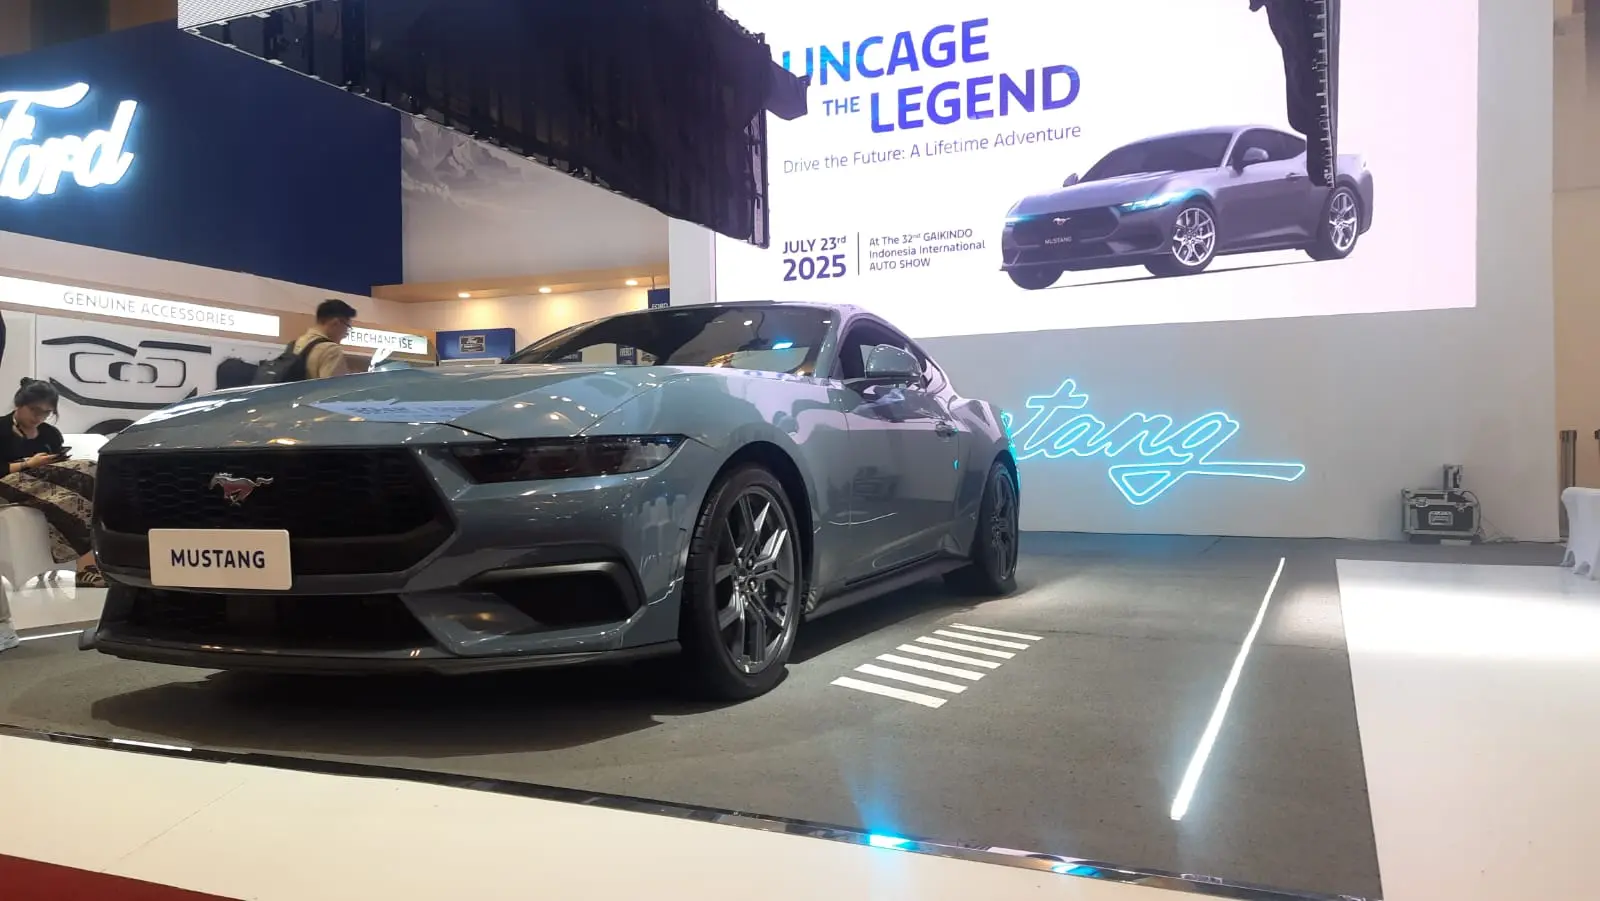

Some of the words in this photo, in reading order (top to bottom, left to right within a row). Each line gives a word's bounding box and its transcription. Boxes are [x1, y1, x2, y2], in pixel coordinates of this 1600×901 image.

[783, 17, 990, 87] UNCAGE
[822, 96, 861, 117] THE
[870, 64, 1081, 134] LEGEND
[0, 82, 138, 200] Ford
[783, 159, 820, 174] Drive
[825, 155, 848, 170] the
[853, 147, 906, 166] Future:
[910, 143, 921, 159] A
[926, 138, 989, 157] Lifetime
[994, 126, 1082, 148] Adventure
[782, 238, 817, 254] JULY
[820, 235, 847, 251] 23rd
[869, 237, 880, 247] At
[881, 236, 900, 246] The
[902, 232, 921, 244] 32nd
[923, 228, 973, 242] GAIKINDO
[869, 248, 917, 259] Indonesia
[919, 240, 986, 255] International
[783, 254, 847, 282] 2025
[869, 260, 897, 271] AUTO
[899, 257, 931, 269] SHOW
[63, 291, 136, 313] GENUINE
[140, 302, 236, 327] ACCESSORIES
[1002, 378, 1306, 505] tang
[170, 548, 266, 570] MUSTANG
